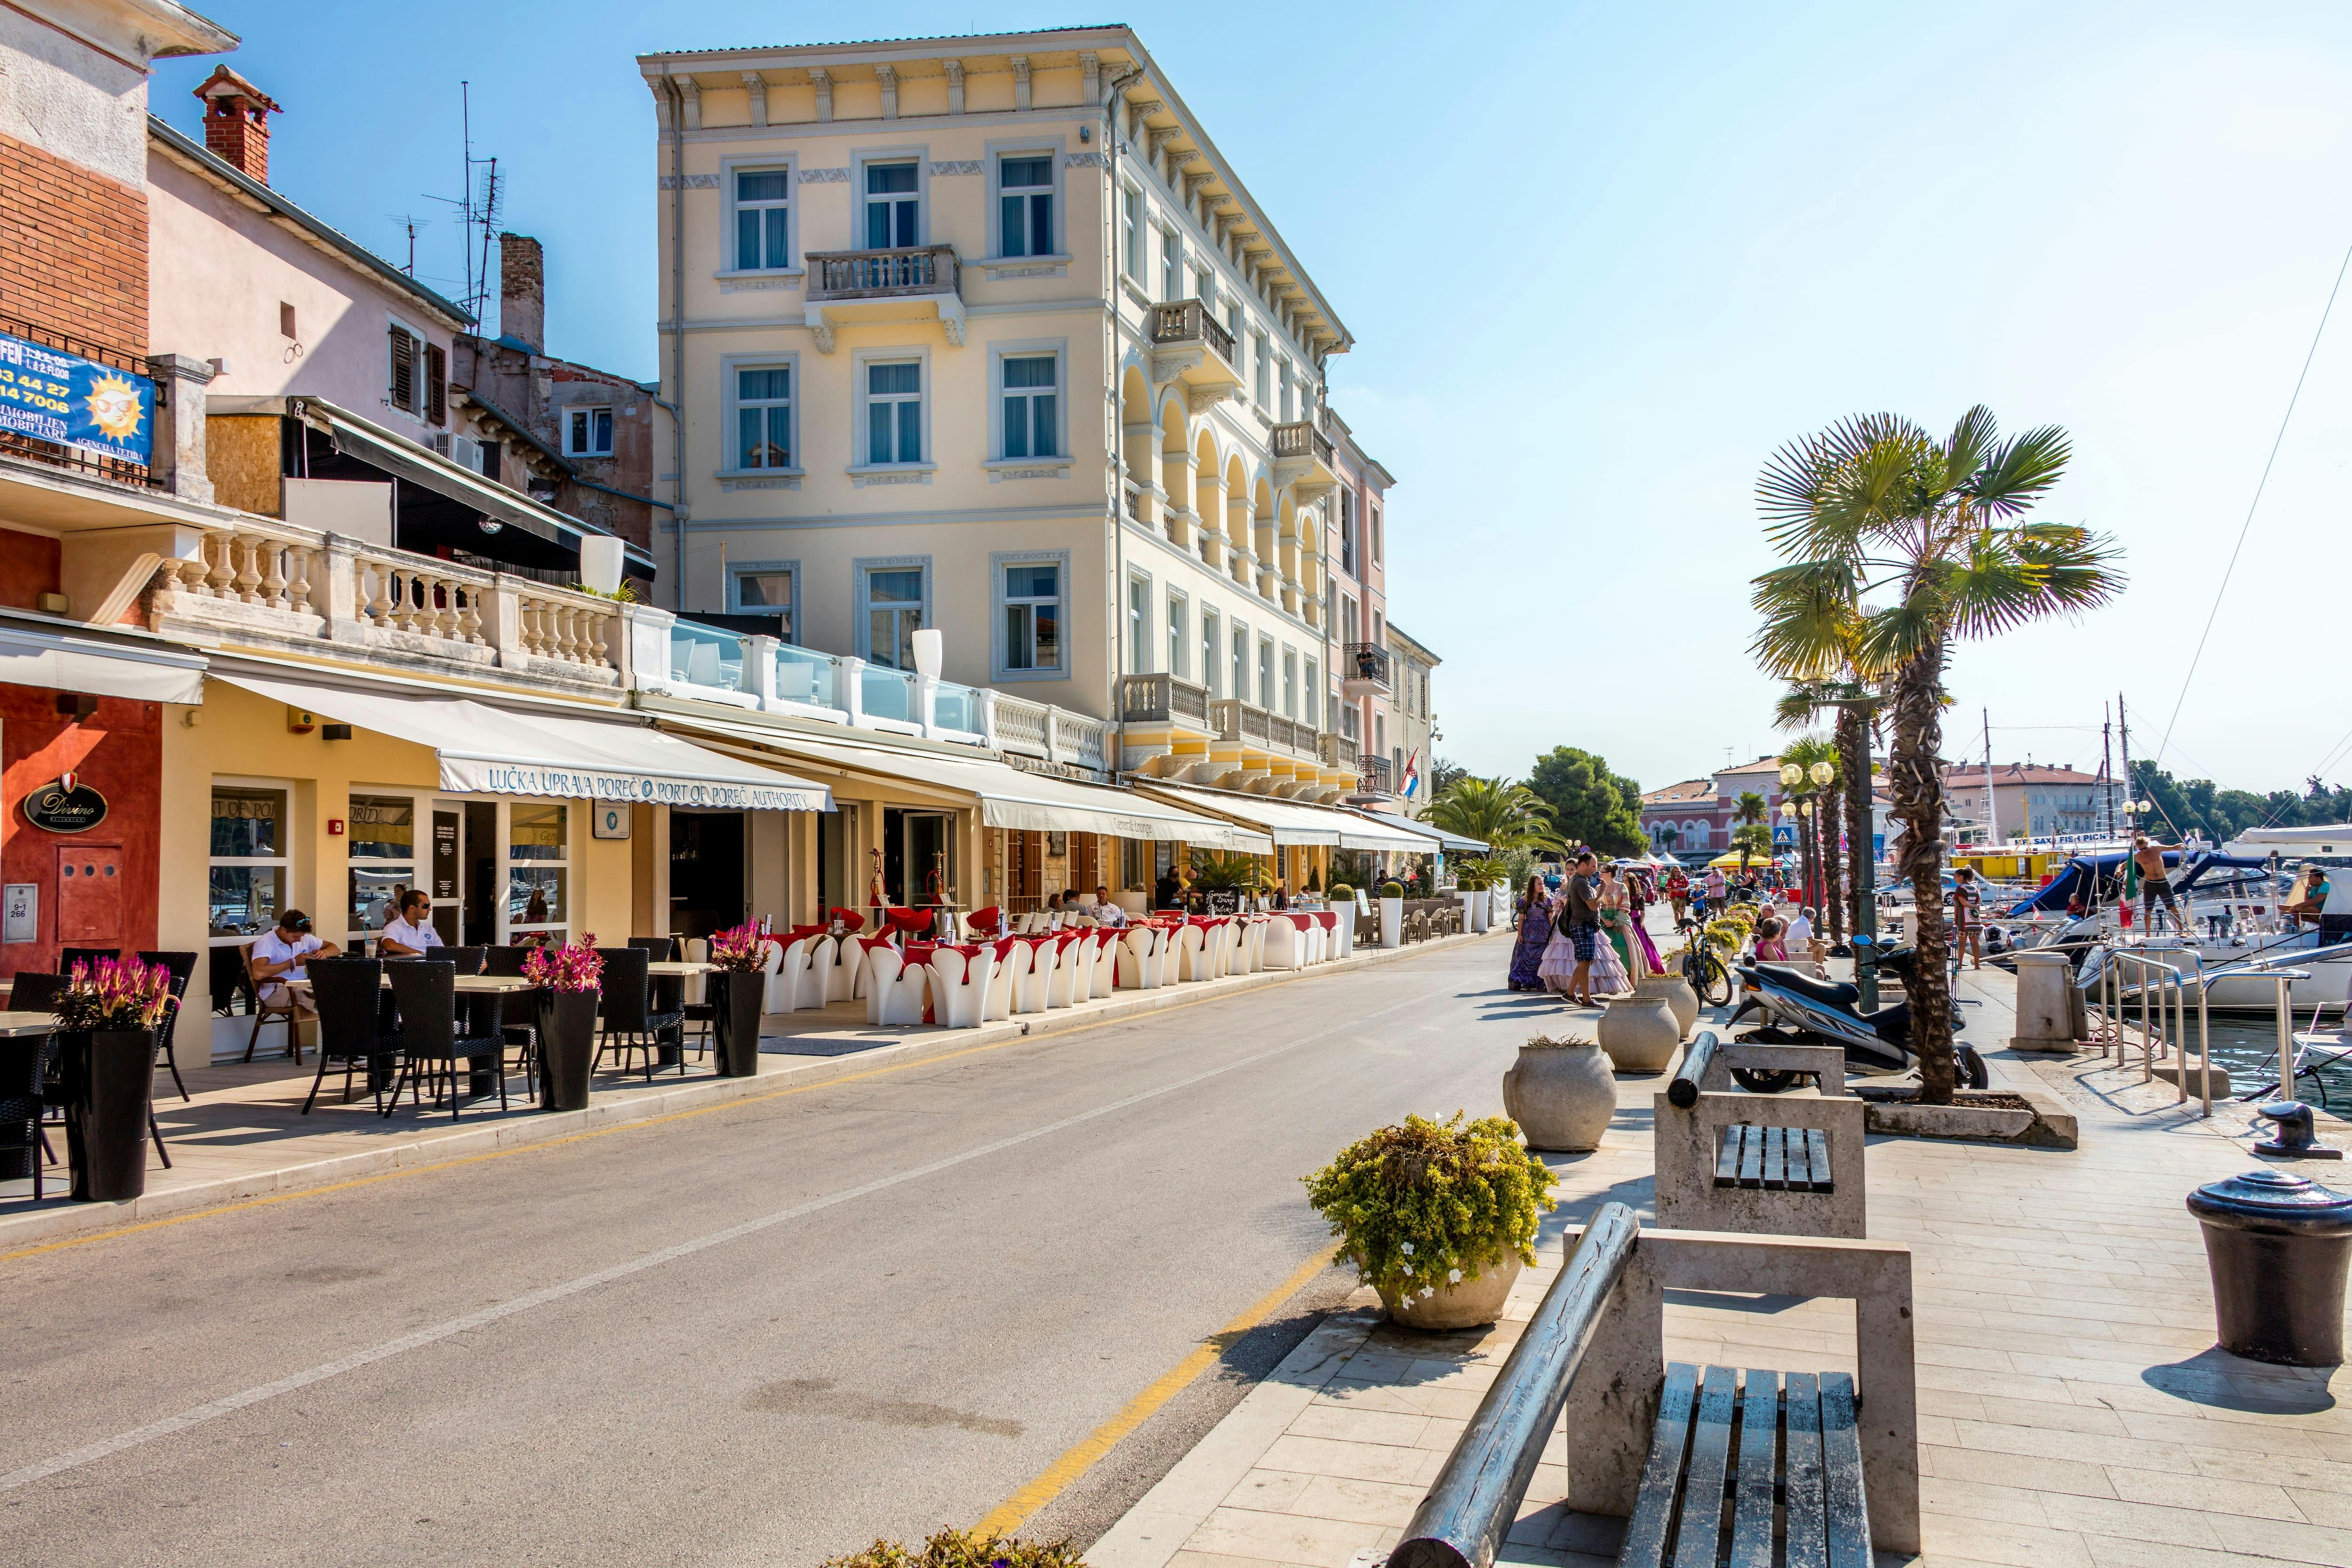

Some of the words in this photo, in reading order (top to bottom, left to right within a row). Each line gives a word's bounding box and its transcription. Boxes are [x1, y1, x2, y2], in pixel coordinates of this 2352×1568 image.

[18, 375, 43, 391] 44
[47, 383, 70, 398] 27
[23, 390, 70, 414] 7006
[75, 437, 115, 454] AGENCIJA
[490, 765, 538, 790] LUČKA
[542, 773, 594, 795] UPRAVA
[598, 776, 638, 797] POREČ
[658, 783, 688, 800] PORT
[690, 786, 706, 801] OF
[713, 786, 747, 804] POREČ
[753, 790, 809, 807] AUTHORITY
[41, 793, 95, 815] Divino
[1113, 818, 1134, 832] General
[1135, 820, 1152, 837] Lounge
[1207, 890, 1231, 899] General
[1216, 897, 1236, 905] Lounge
